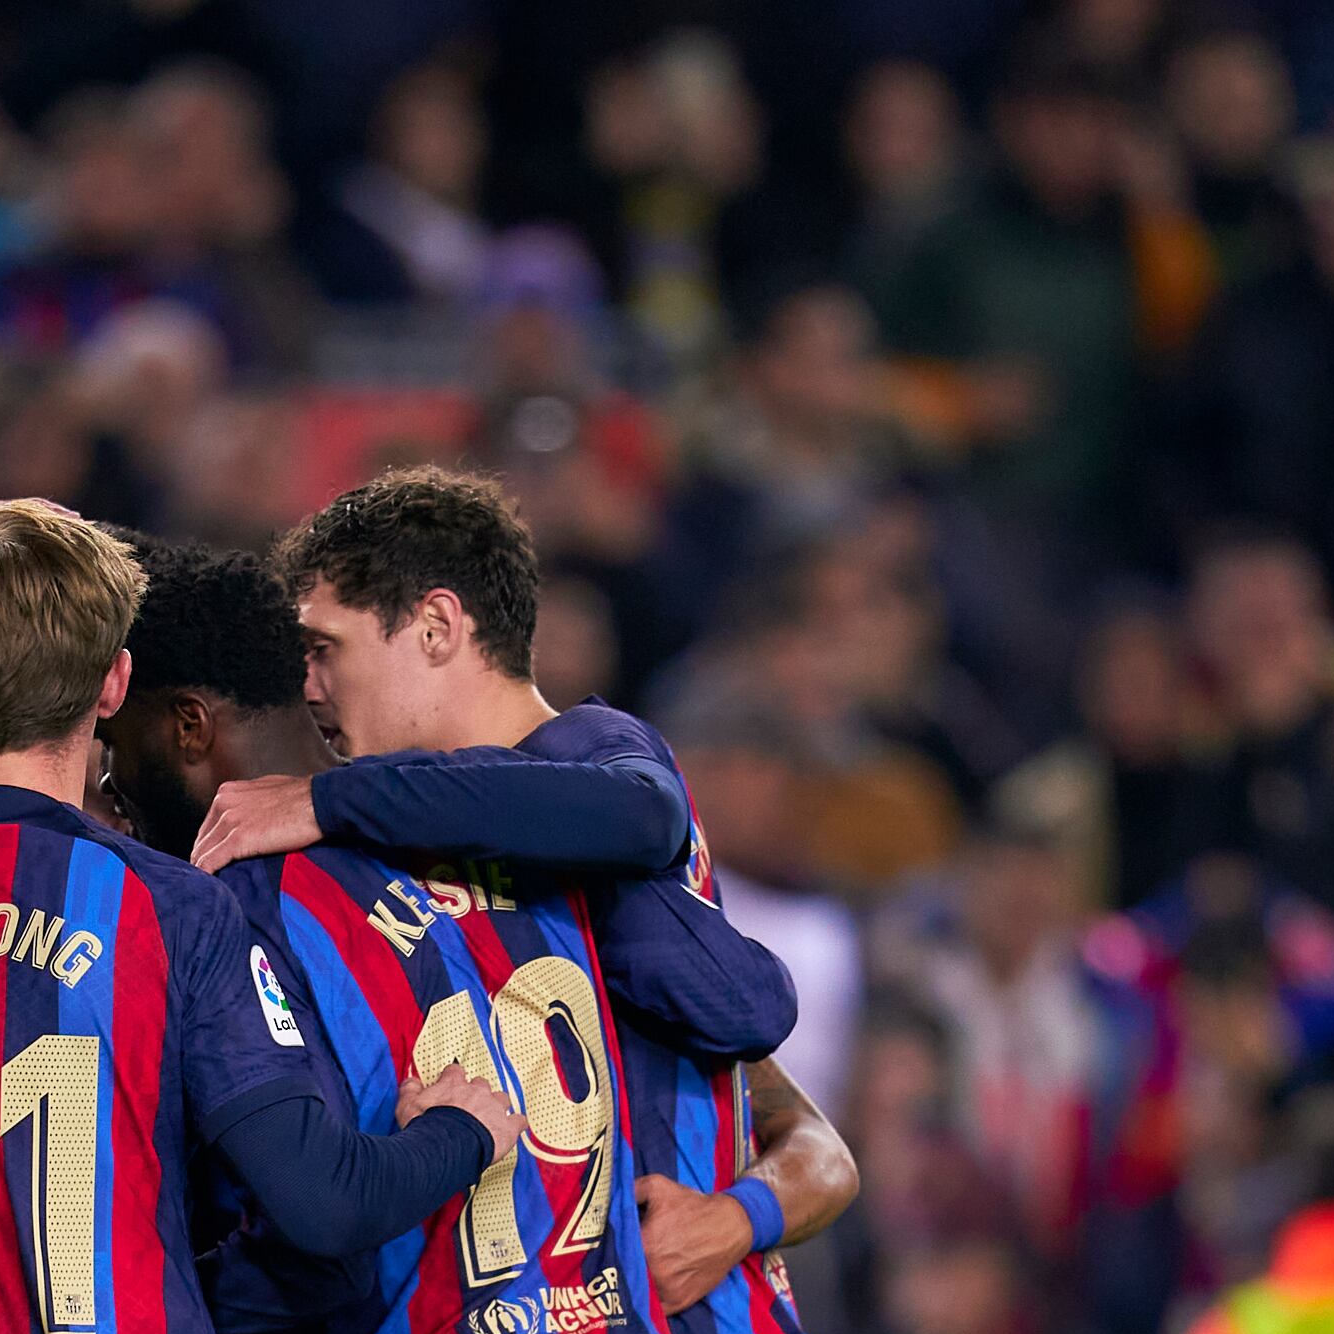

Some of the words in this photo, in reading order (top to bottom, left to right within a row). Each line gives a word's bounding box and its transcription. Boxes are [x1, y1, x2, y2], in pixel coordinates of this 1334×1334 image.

[367, 862, 517, 958] KESIE
[273, 1016, 297, 1031] LaL
[408, 955, 615, 1289] 19
[539, 1266, 619, 1311] UNHCR
[545, 1291, 624, 1334] ACNUR
